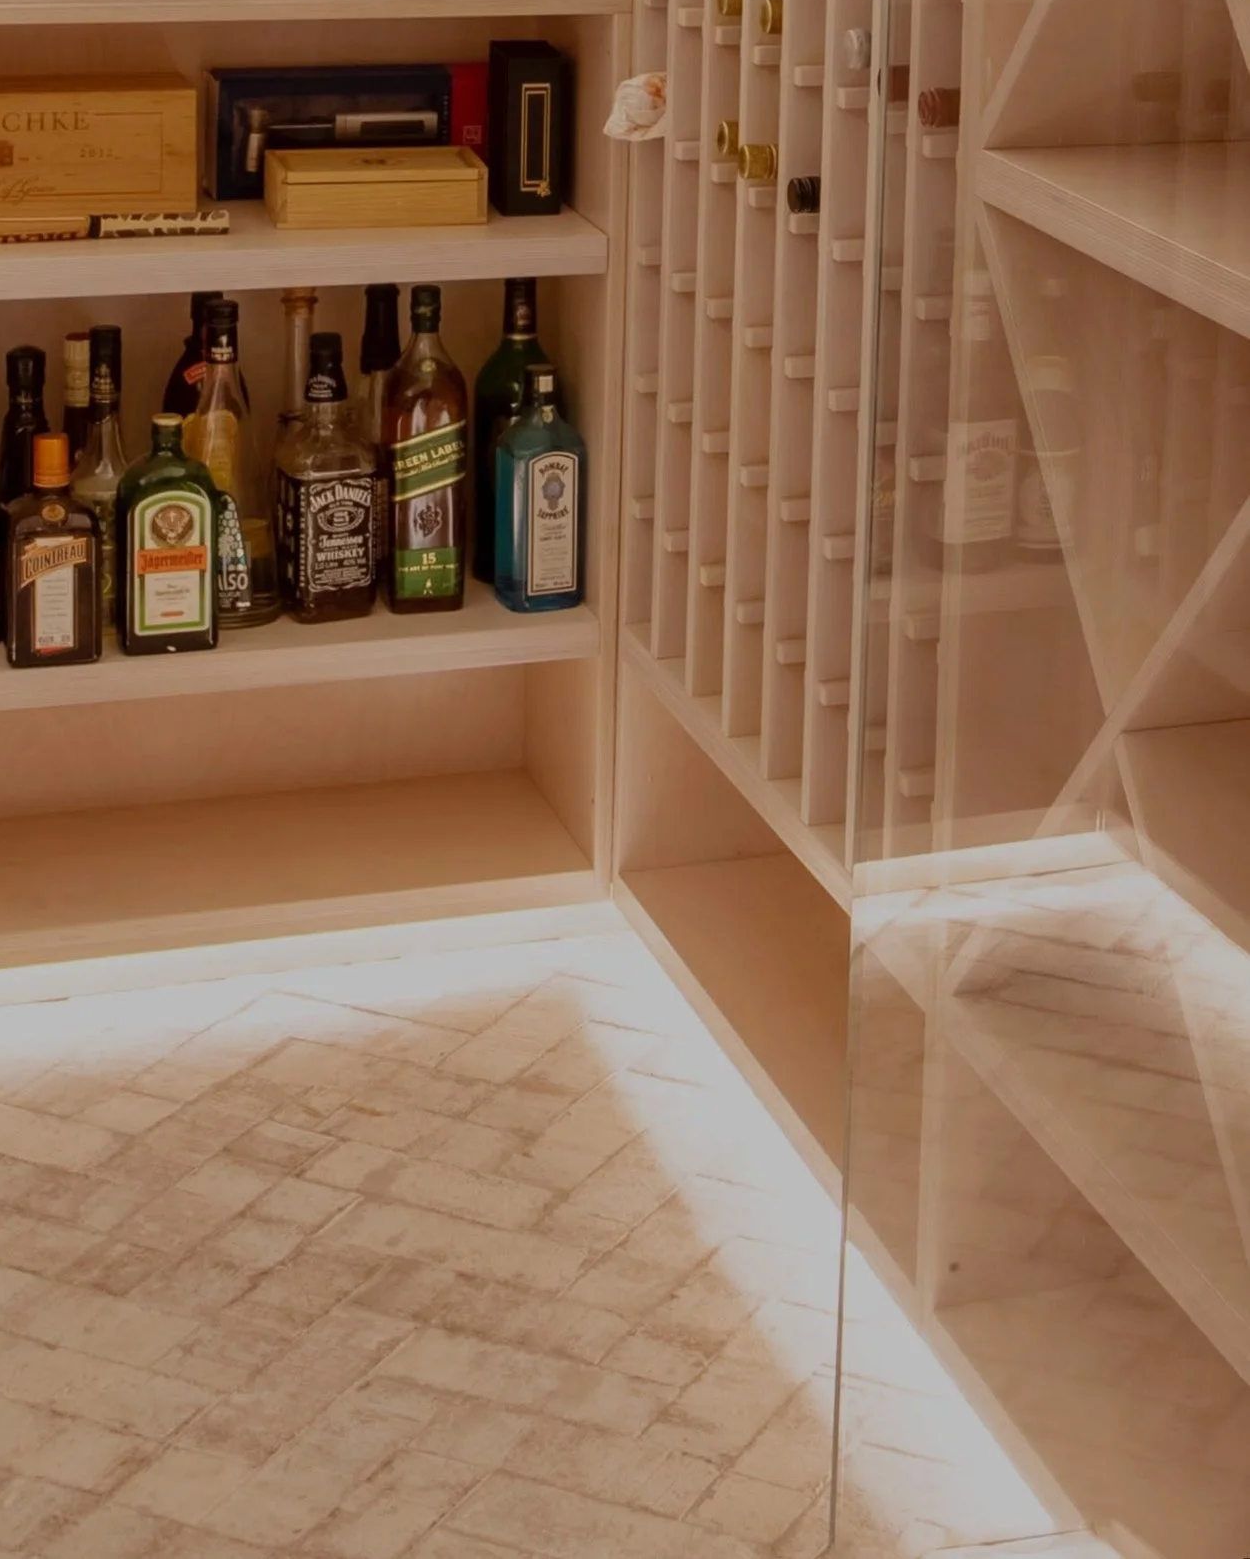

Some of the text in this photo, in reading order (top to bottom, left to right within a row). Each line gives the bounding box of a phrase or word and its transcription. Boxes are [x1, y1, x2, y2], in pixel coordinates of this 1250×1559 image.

[394, 451, 429, 472] REEN
[538, 461, 570, 477] BOMBAY
[309, 490, 336, 513] JACK
[536, 505, 570, 520] SAPPHIRE
[25, 543, 84, 580] COINTREAU
[316, 546, 366, 562] WHISKEY
[421, 552, 437, 565] 15
